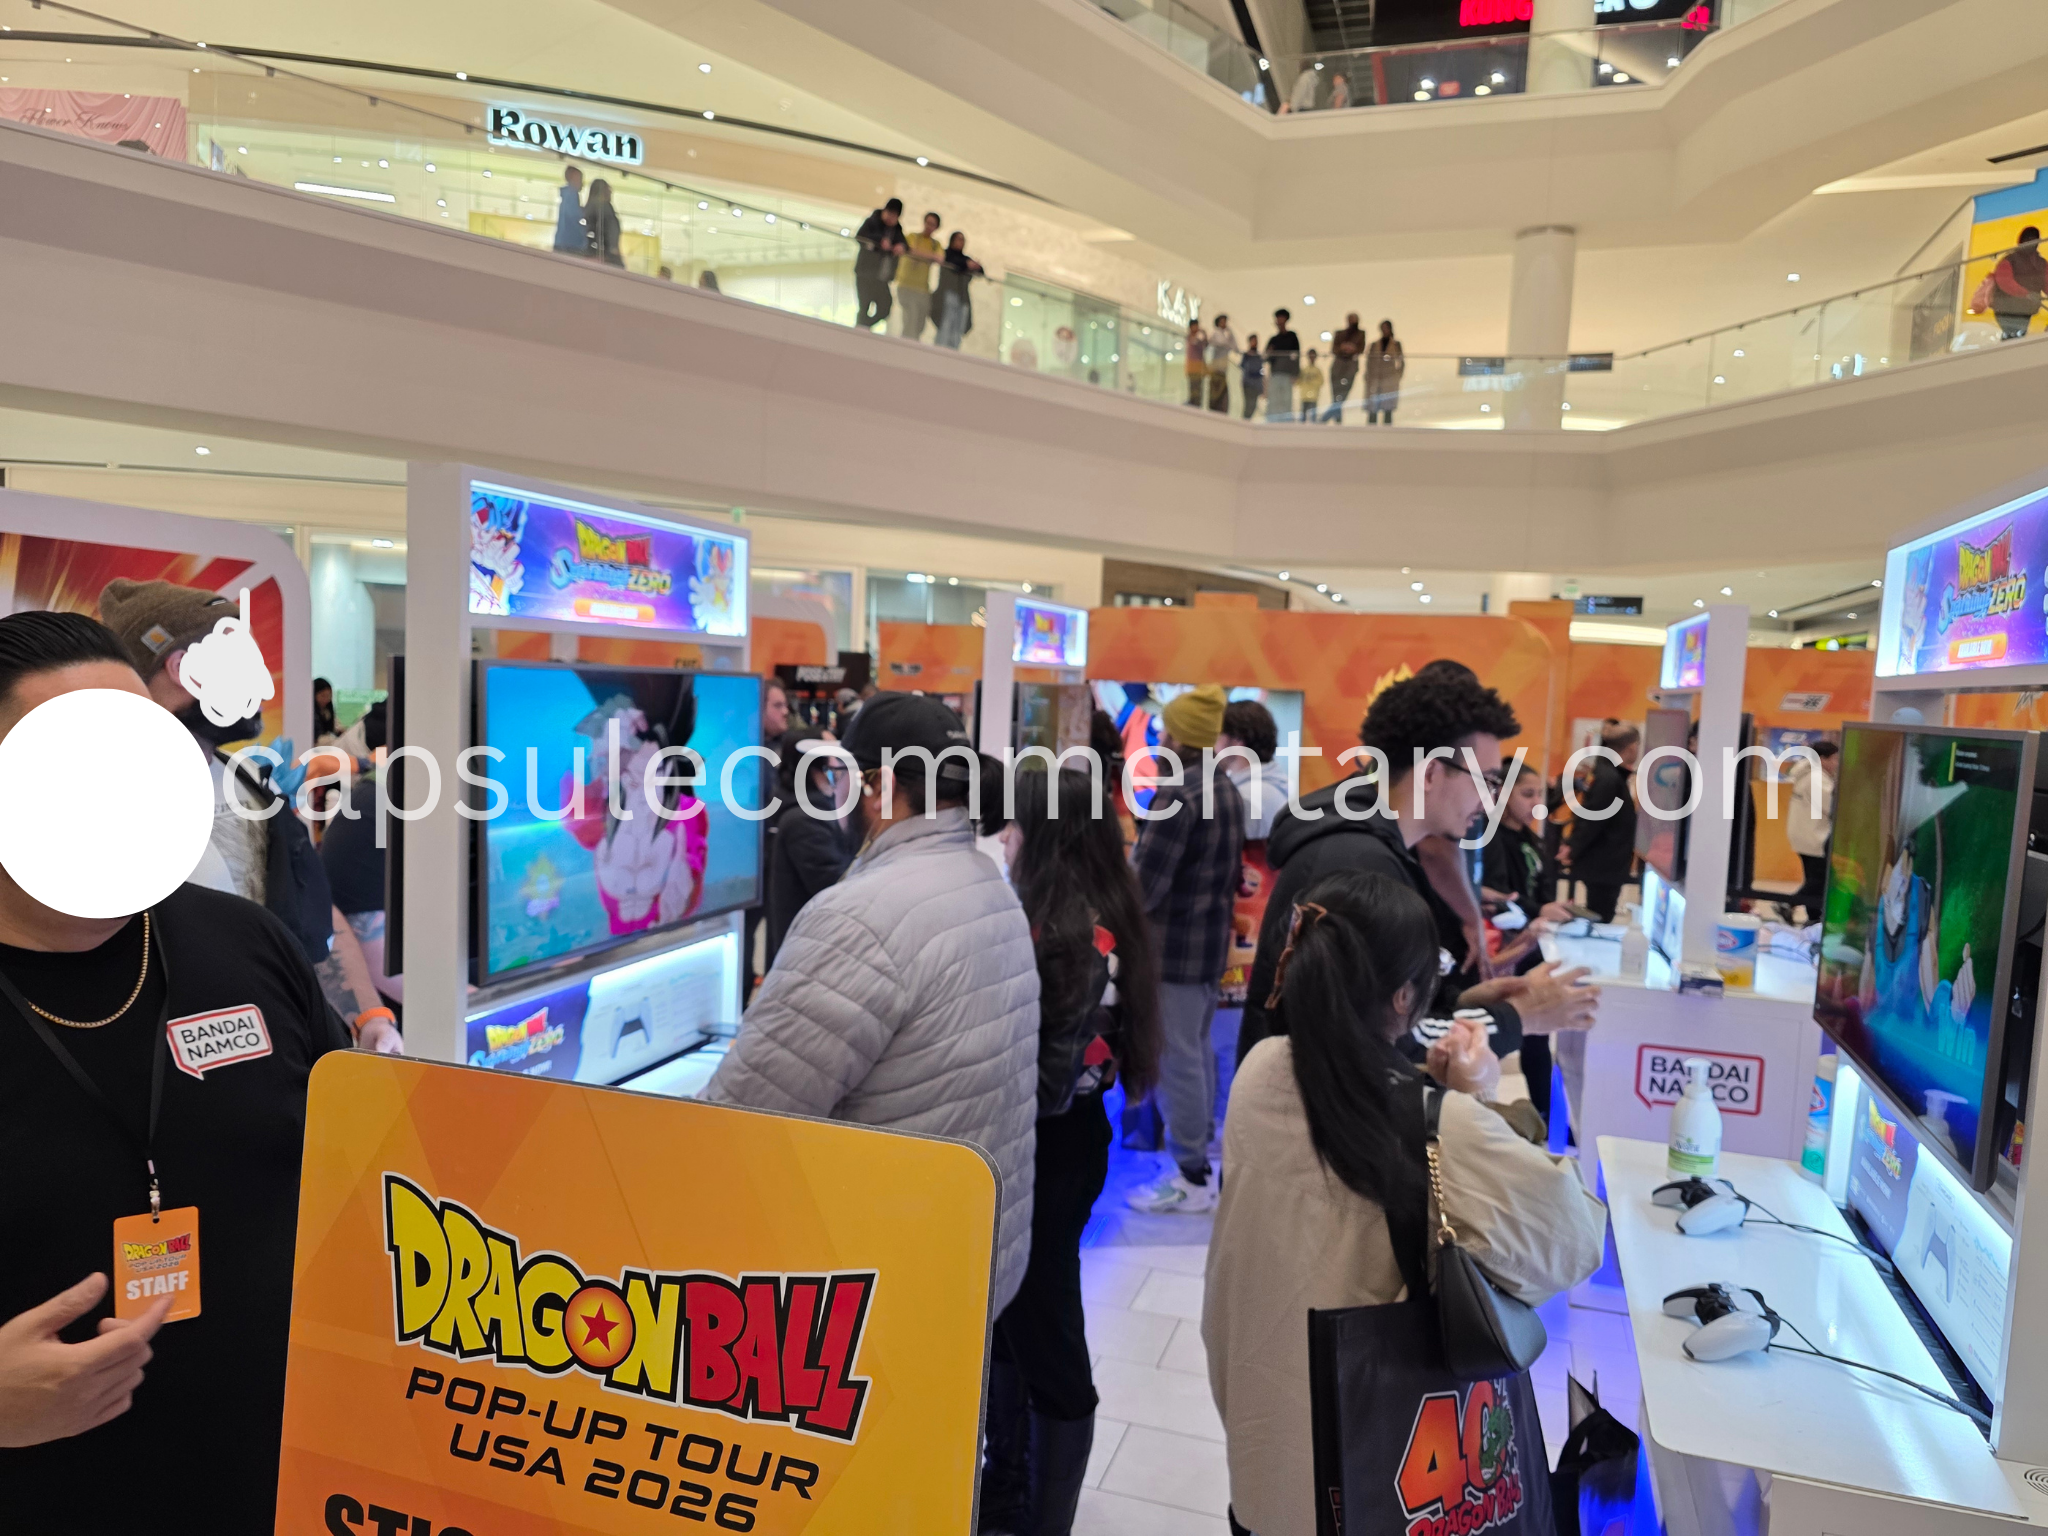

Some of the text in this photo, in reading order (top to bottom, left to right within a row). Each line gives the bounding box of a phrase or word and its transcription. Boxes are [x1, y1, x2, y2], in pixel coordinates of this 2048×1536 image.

[490, 107, 640, 161] Rowan
[181, 1016, 255, 1044] BANDAI
[187, 1033, 260, 1061] NAMCO
[1651, 1056, 1750, 1083] BADAI
[1650, 1077, 1749, 1103] NACO
[122, 1233, 191, 1262] DRAGON BALL
[126, 1270, 189, 1300] STAFF
[383, 1171, 880, 1445] DRAGON BALL
[405, 1366, 820, 1500] POP-UP TOUR
[449, 1423, 759, 1533] USA 2026
